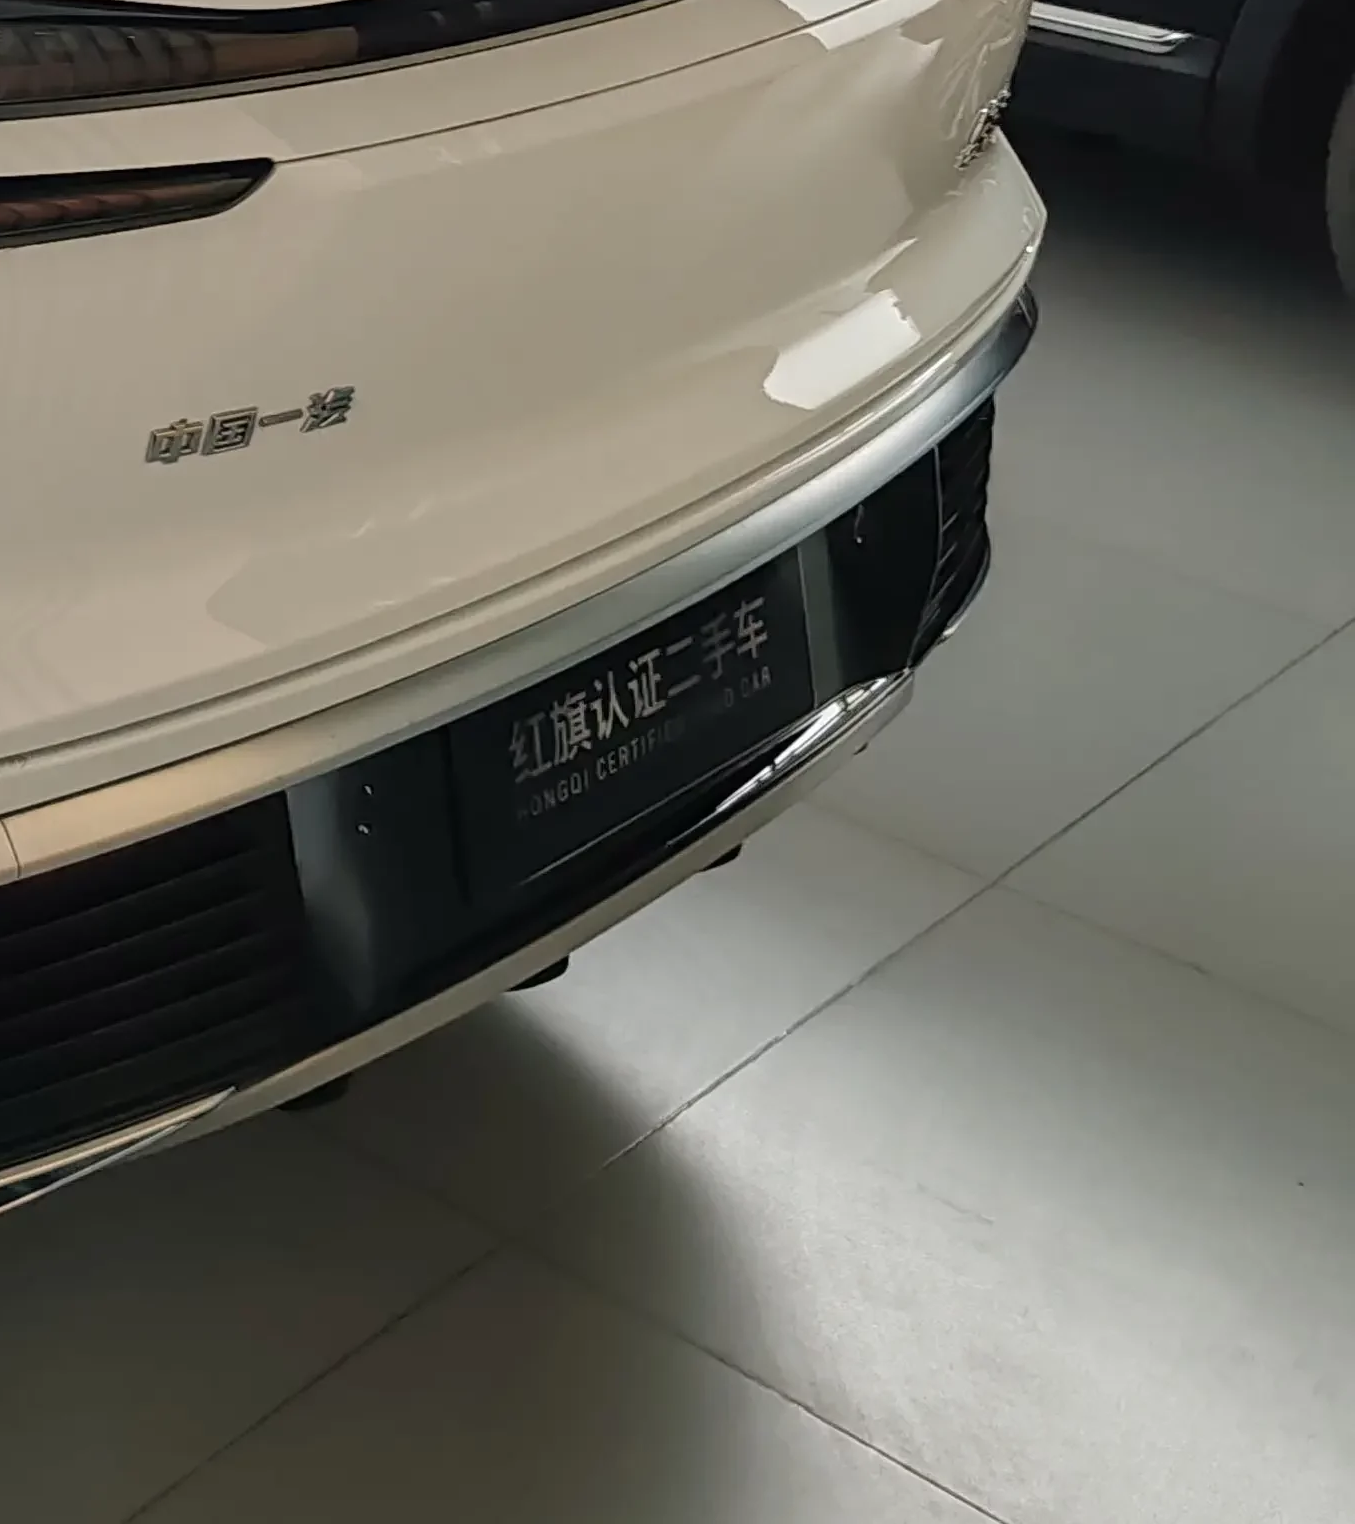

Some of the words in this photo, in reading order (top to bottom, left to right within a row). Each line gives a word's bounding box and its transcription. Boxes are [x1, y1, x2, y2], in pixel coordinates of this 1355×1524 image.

[144, 385, 356, 464] 中国一汽
[508, 595, 770, 784] 红旗认证二手车
